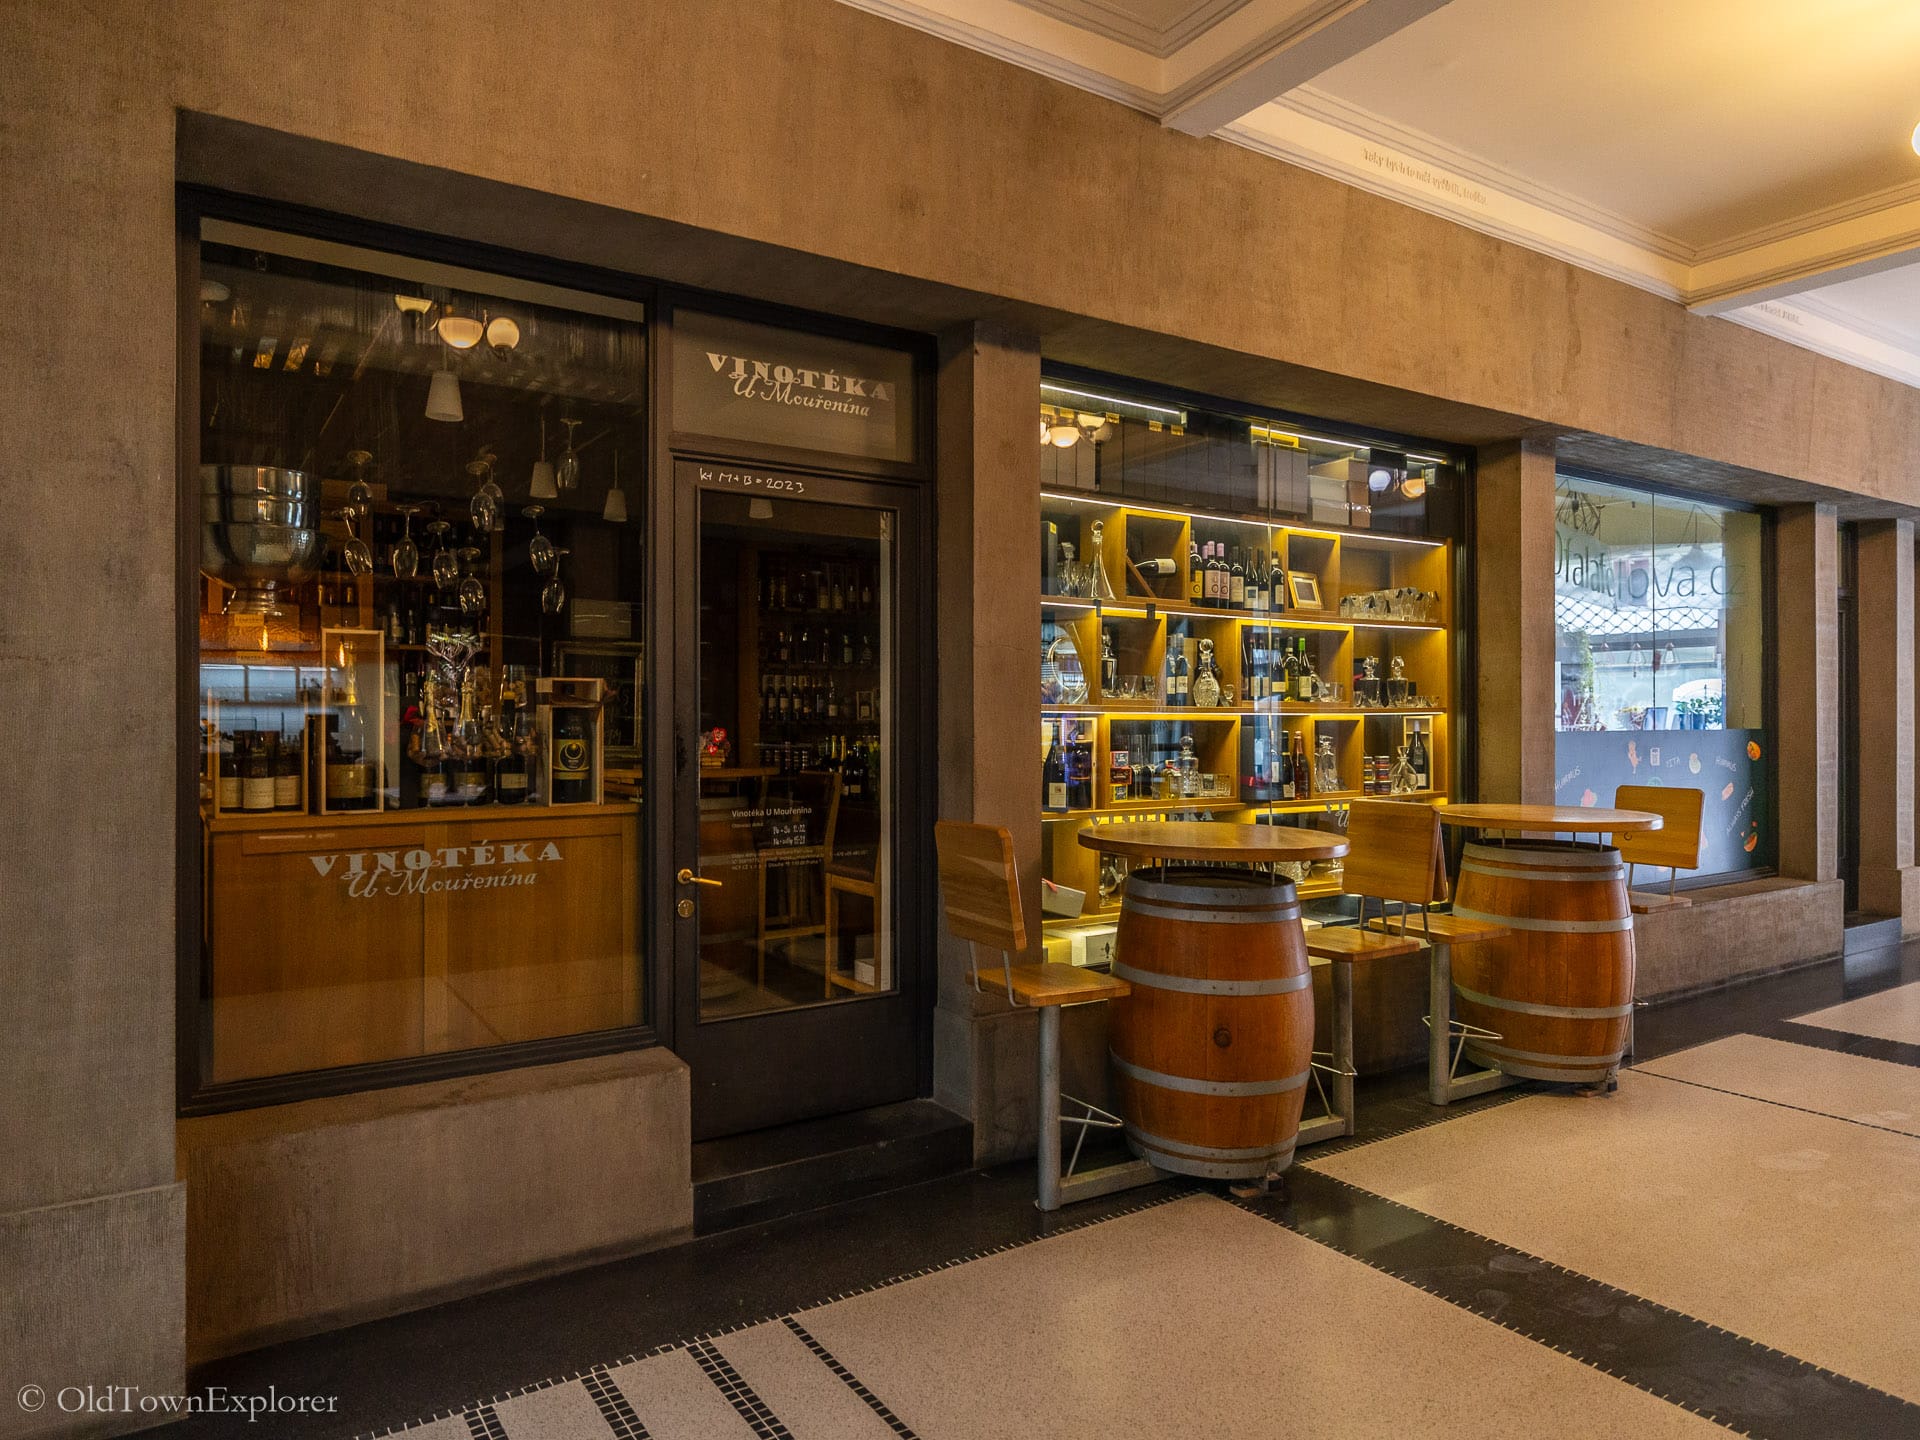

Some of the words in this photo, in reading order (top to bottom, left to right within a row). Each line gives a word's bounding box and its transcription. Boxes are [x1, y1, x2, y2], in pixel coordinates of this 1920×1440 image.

[706, 352, 889, 400] VINOTÉKA
[760, 378, 870, 416] Mouřenína
[766, 478, 804, 493] 2023
[732, 809, 764, 817] Vinotéka
[309, 840, 564, 877] VINOTÉKA
[340, 871, 379, 898] U
[385, 869, 538, 897] Mouřenína
